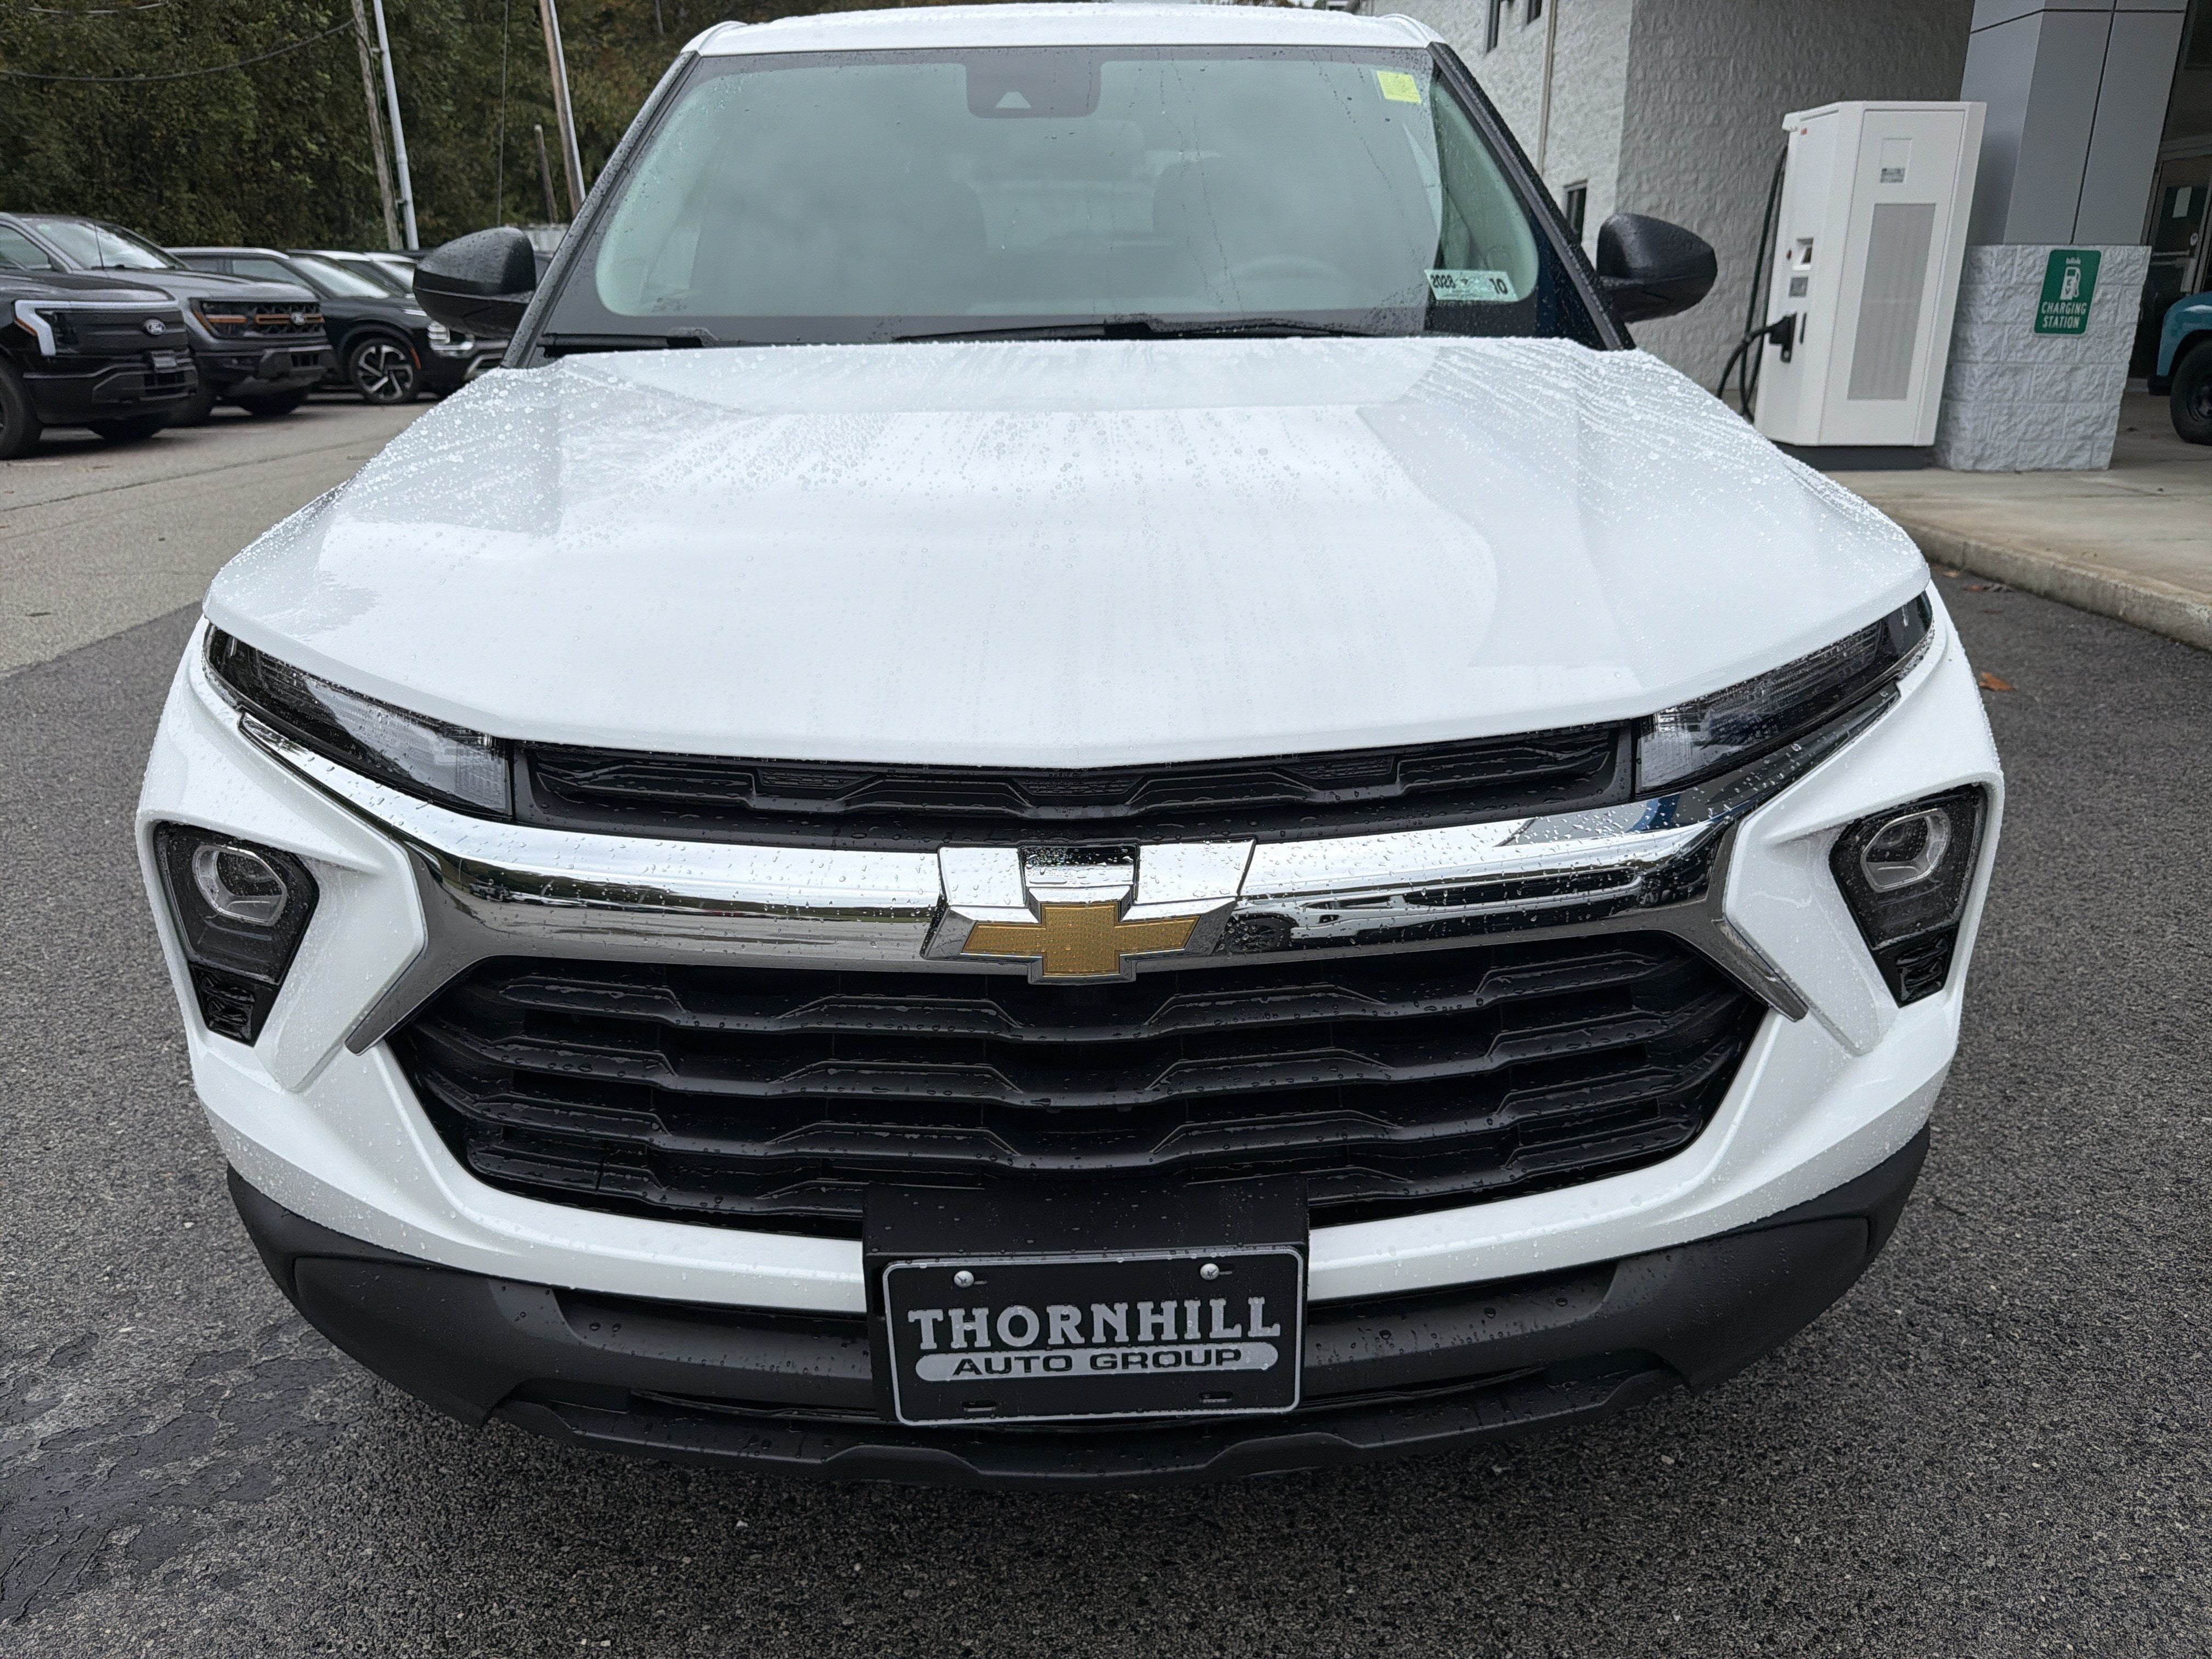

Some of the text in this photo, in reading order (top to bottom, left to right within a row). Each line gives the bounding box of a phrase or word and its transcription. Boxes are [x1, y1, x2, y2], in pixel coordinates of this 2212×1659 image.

[1488, 278, 1508, 295] 10
[2041, 301, 2087, 315] CHARGING
[2042, 315, 2080, 329] STATION
[908, 1296, 1281, 1350] THORNHILL
[952, 1348, 1242, 1376] AUTO GROUP
